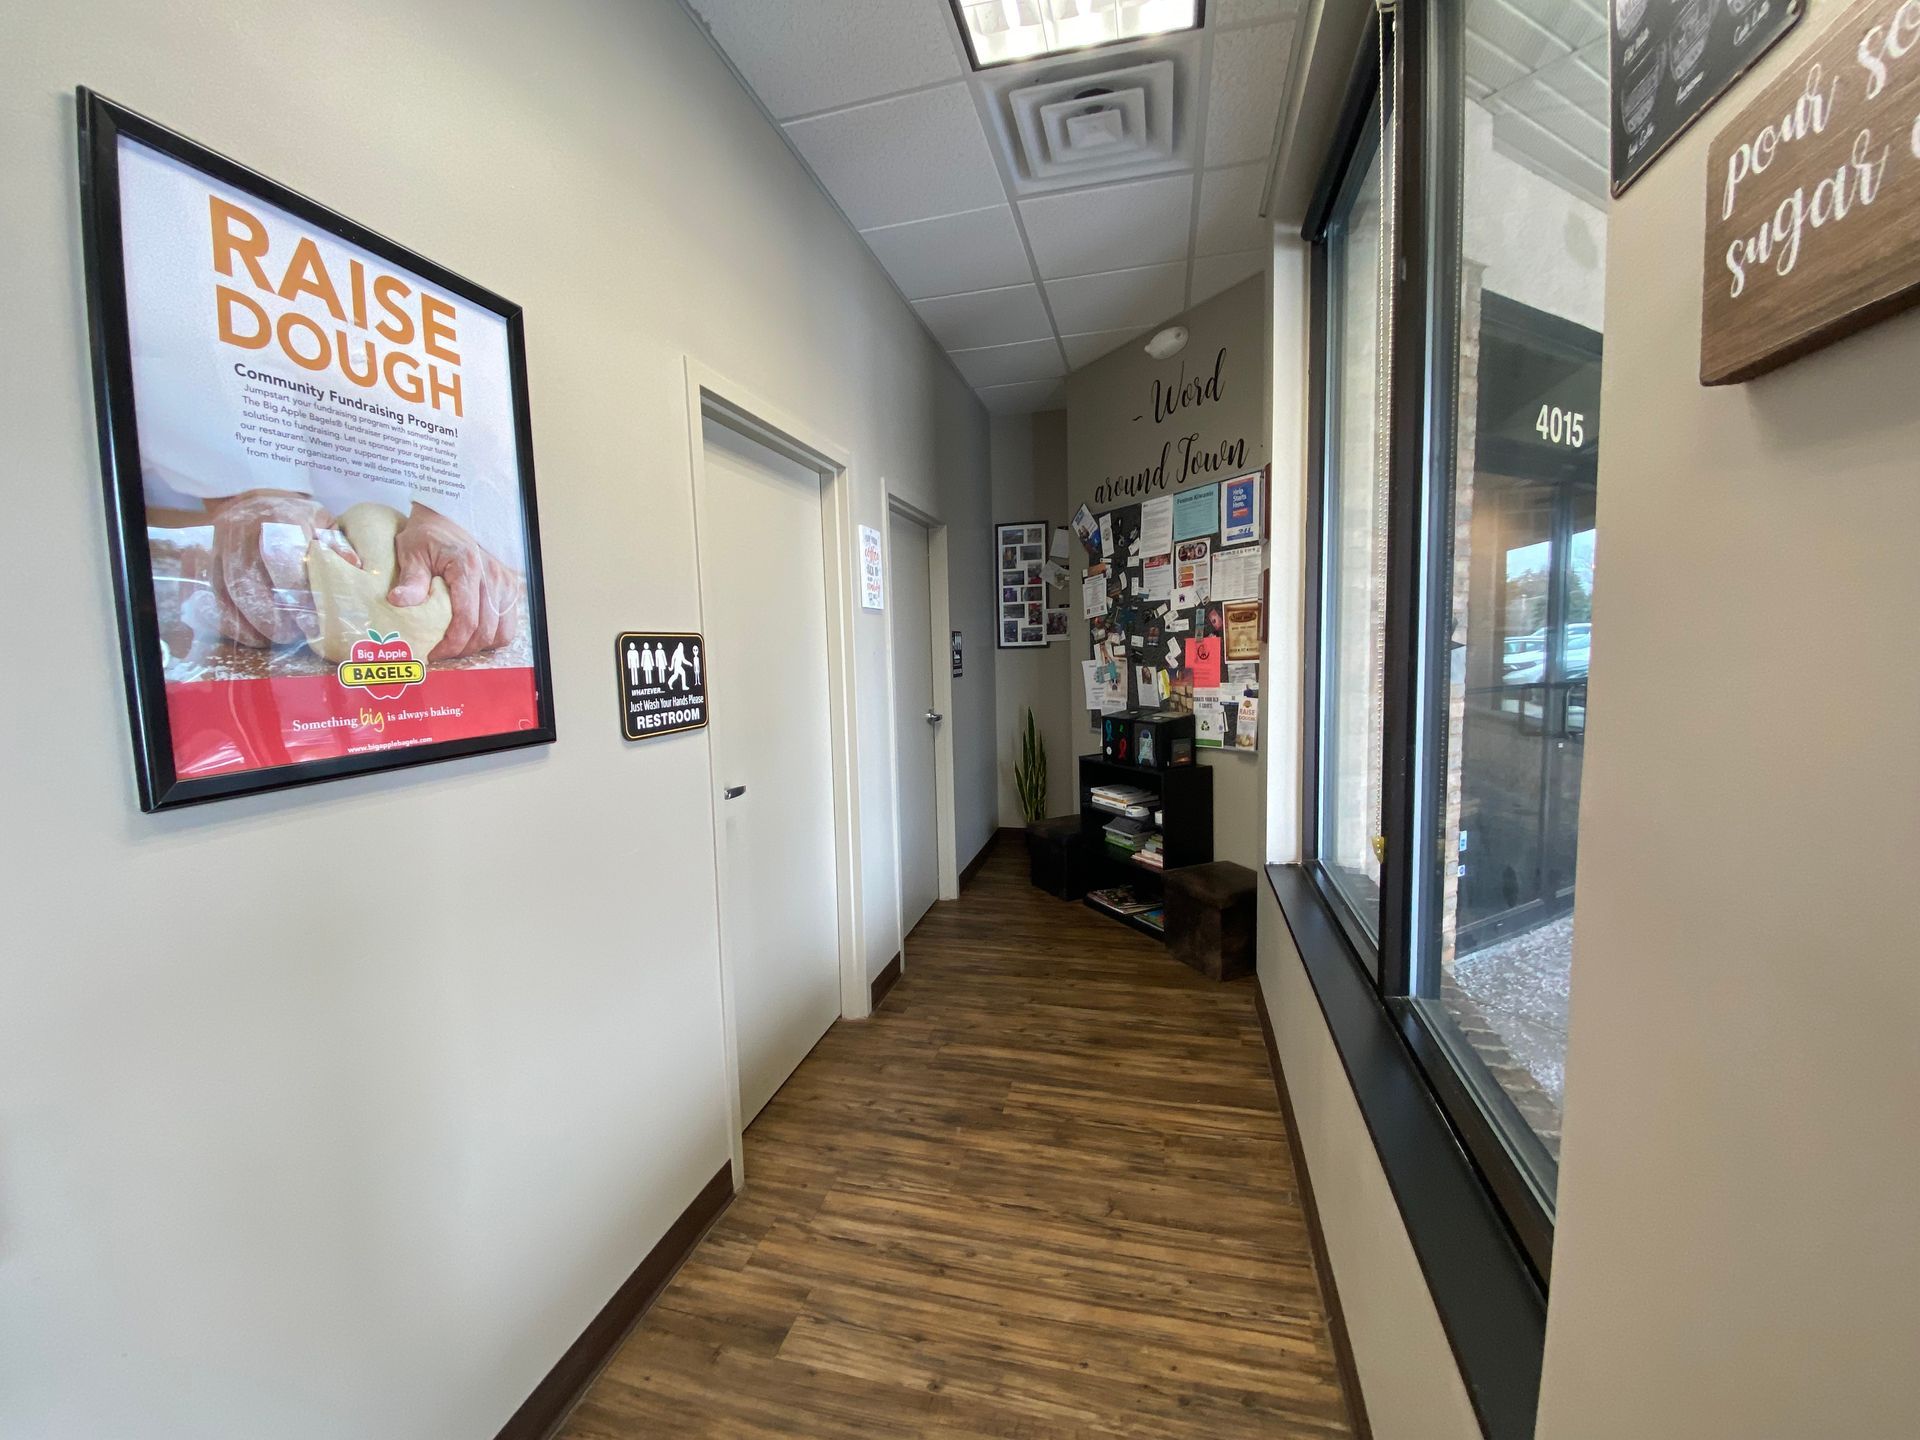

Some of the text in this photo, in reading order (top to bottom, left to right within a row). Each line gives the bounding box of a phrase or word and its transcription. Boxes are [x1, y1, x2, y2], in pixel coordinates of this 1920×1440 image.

[1723, 63, 1840, 221] pour
[1726, 129, 1890, 298] sugar
[209, 194, 461, 366] RAISE
[215, 283, 464, 418] DOUGH
[234, 363, 458, 438] Community Fundraising Program!
[244, 384, 290, 402] Jumpstart
[292, 398, 311, 408] your
[314, 401, 357, 422] fundraising
[359, 416, 390, 429] program
[391, 425, 406, 434] with
[407, 430, 440, 445] something
[1151, 347, 1227, 424] Word
[240, 421, 461, 479] our restaurant. When your supporter presents the fundraiser
[242, 396, 260, 407] The
[263, 401, 278, 413] Big
[281, 406, 307, 419] Apple
[344, 421, 381, 438] fundraiser
[383, 434, 412, 447] program
[420, 444, 433, 452] your
[435, 447, 458, 460] turnkey
[242, 410, 279, 425] solution
[282, 419, 292, 427] to
[294, 420, 342, 440] fundraising.
[344, 433, 356, 442] Let
[368, 440, 396, 453] sponsor
[397, 448, 412, 457] your
[414, 452, 451, 467] organization
[1535, 404, 1585, 448] 4015
[235, 431, 256, 444] flyer
[259, 436, 272, 446] for
[275, 442, 295, 452] your
[297, 446, 350, 464] organization,
[364, 460, 376, 469] will
[378, 463, 402, 475] donate
[403, 469, 418, 480] 15%
[427, 475, 437, 483] the
[438, 478, 466, 490] proceeds
[246, 446, 269, 459] from
[271, 452, 292, 464] their
[294, 457, 332, 472] purchase
[333, 464, 343, 474] to
[344, 470, 361, 479] your
[432, 485, 444, 495] that
[1095, 432, 1250, 504] around Town
[353, 666, 413, 681] BAGELS
[358, 648, 407, 661] Big Apple
[292, 716, 358, 732] Something
[360, 707, 385, 733] big
[387, 711, 396, 722] is
[398, 709, 429, 722] always
[630, 694, 704, 713] Just Wash Your Hands Please
[631, 687, 665, 696] WHATEVER...
[636, 707, 700, 730] RESTROOM
[347, 736, 433, 753] www.bigapplebagels.com
